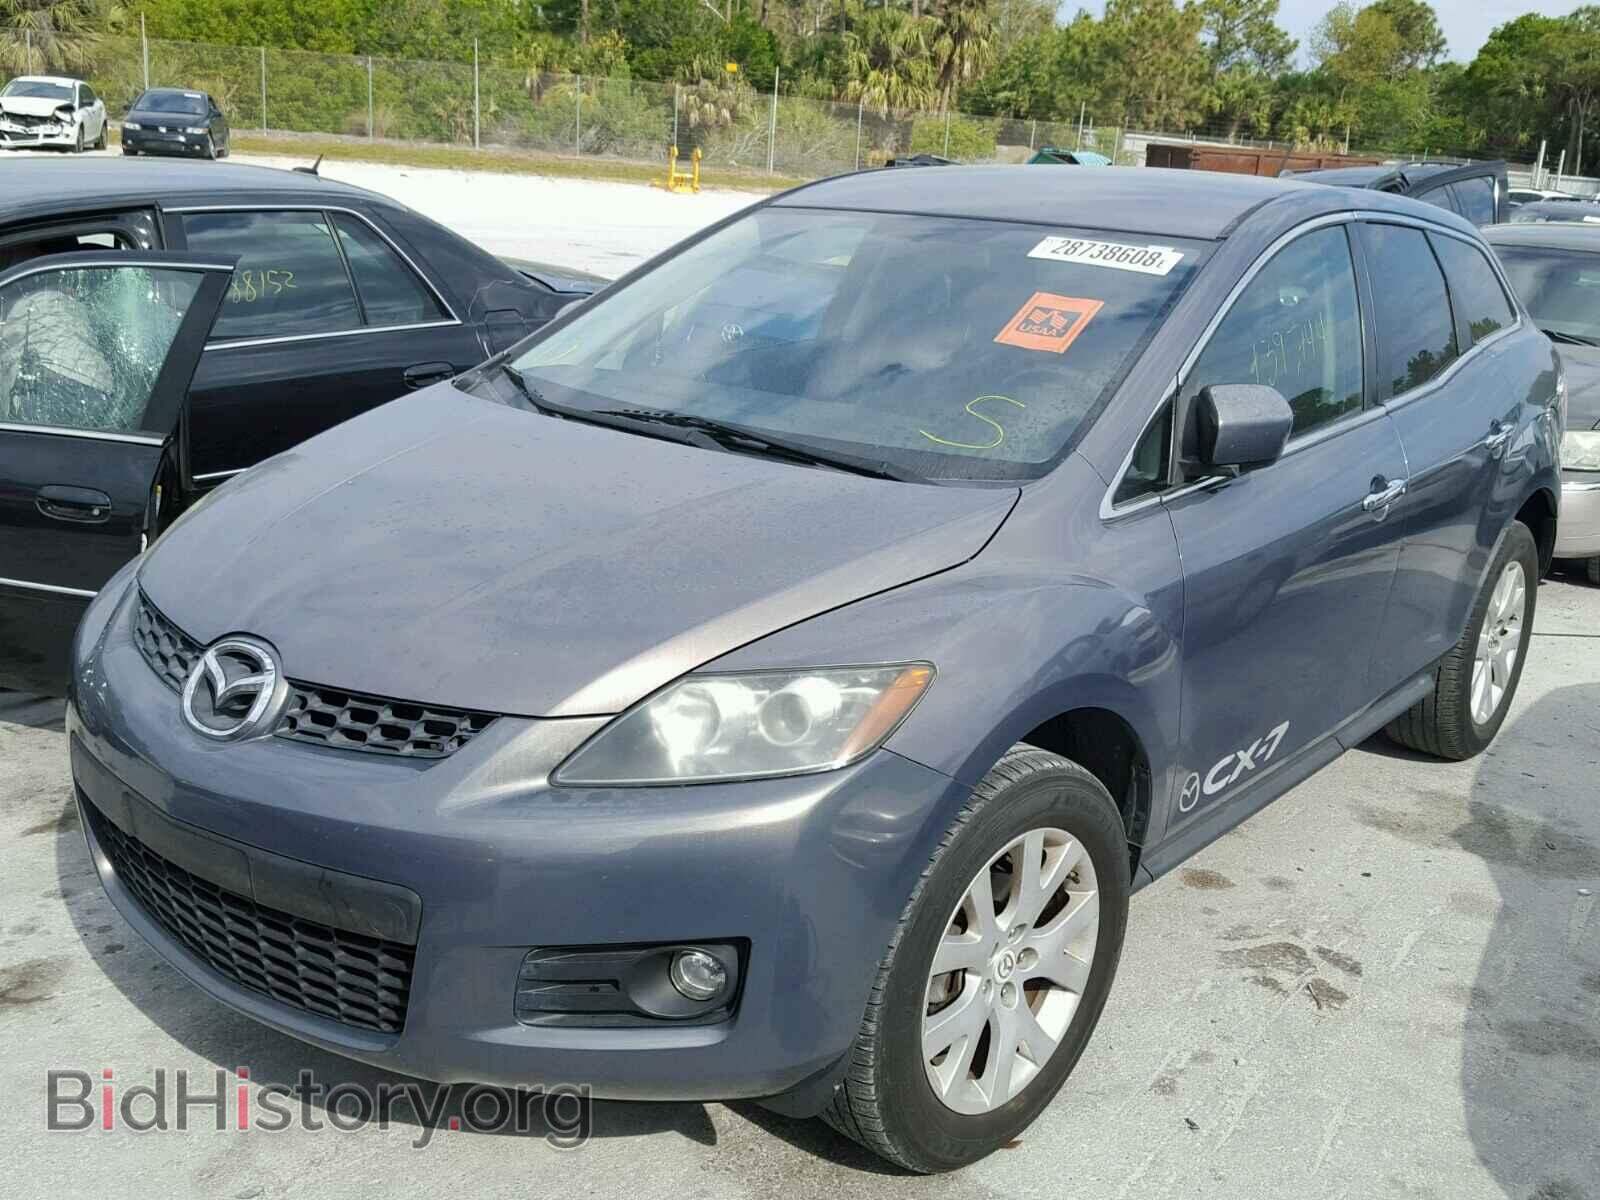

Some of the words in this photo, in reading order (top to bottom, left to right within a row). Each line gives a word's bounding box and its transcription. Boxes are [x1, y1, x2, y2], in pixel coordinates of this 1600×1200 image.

[1051, 240, 1162, 267] 28738608
[1019, 322, 1058, 337] USAA
[919, 394, 1026, 449] S
[1202, 720, 1290, 795] CX-7
